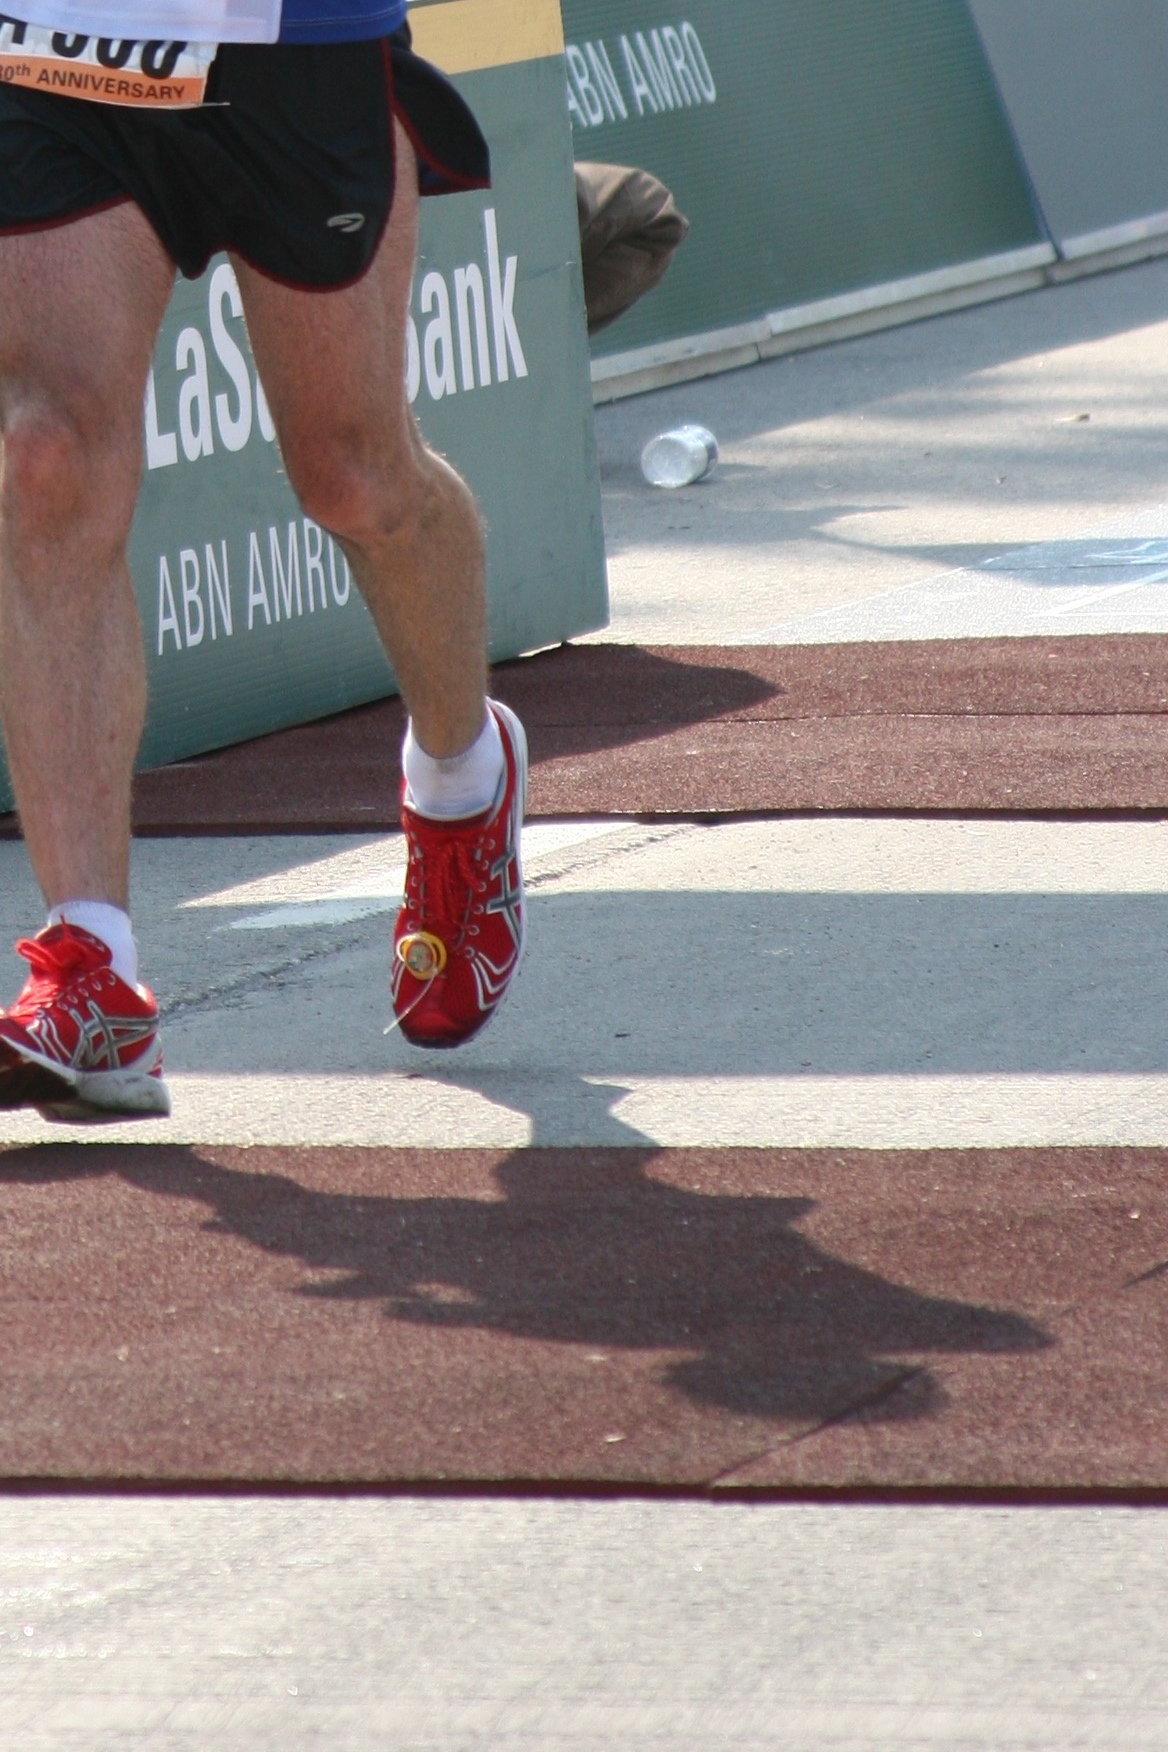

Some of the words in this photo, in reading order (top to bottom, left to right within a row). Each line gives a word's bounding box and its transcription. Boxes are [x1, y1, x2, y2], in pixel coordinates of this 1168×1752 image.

[36, 67, 186, 100] ANNIVERSARY
[620, 20, 718, 116] AMRO
[157, 539, 233, 657] ABN
